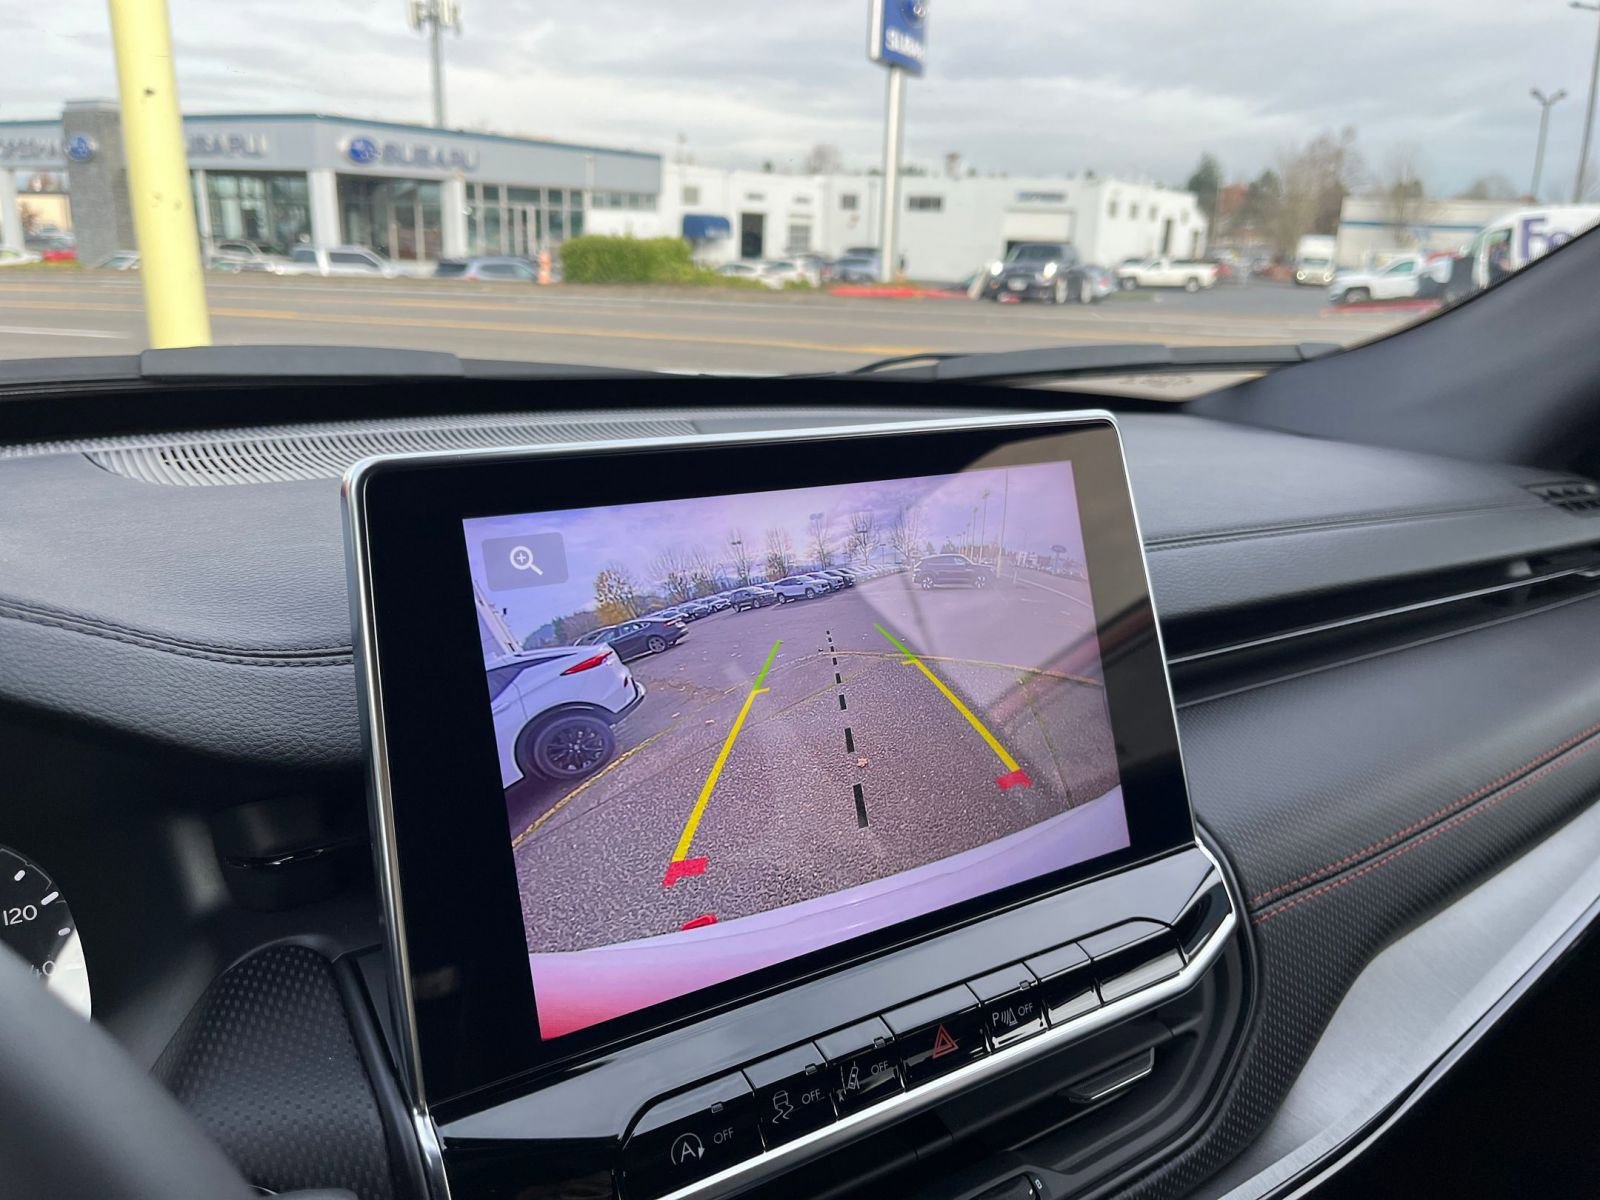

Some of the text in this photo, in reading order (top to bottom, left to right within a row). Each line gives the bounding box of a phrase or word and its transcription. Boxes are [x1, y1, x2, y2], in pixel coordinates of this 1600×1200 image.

[3, 905, 38, 926] 120
[1018, 1002, 1033, 1016] OFF
[870, 1060, 889, 1075] OFF
[801, 1089, 821, 1105] OFF
[713, 1127, 735, 1144] OFF
